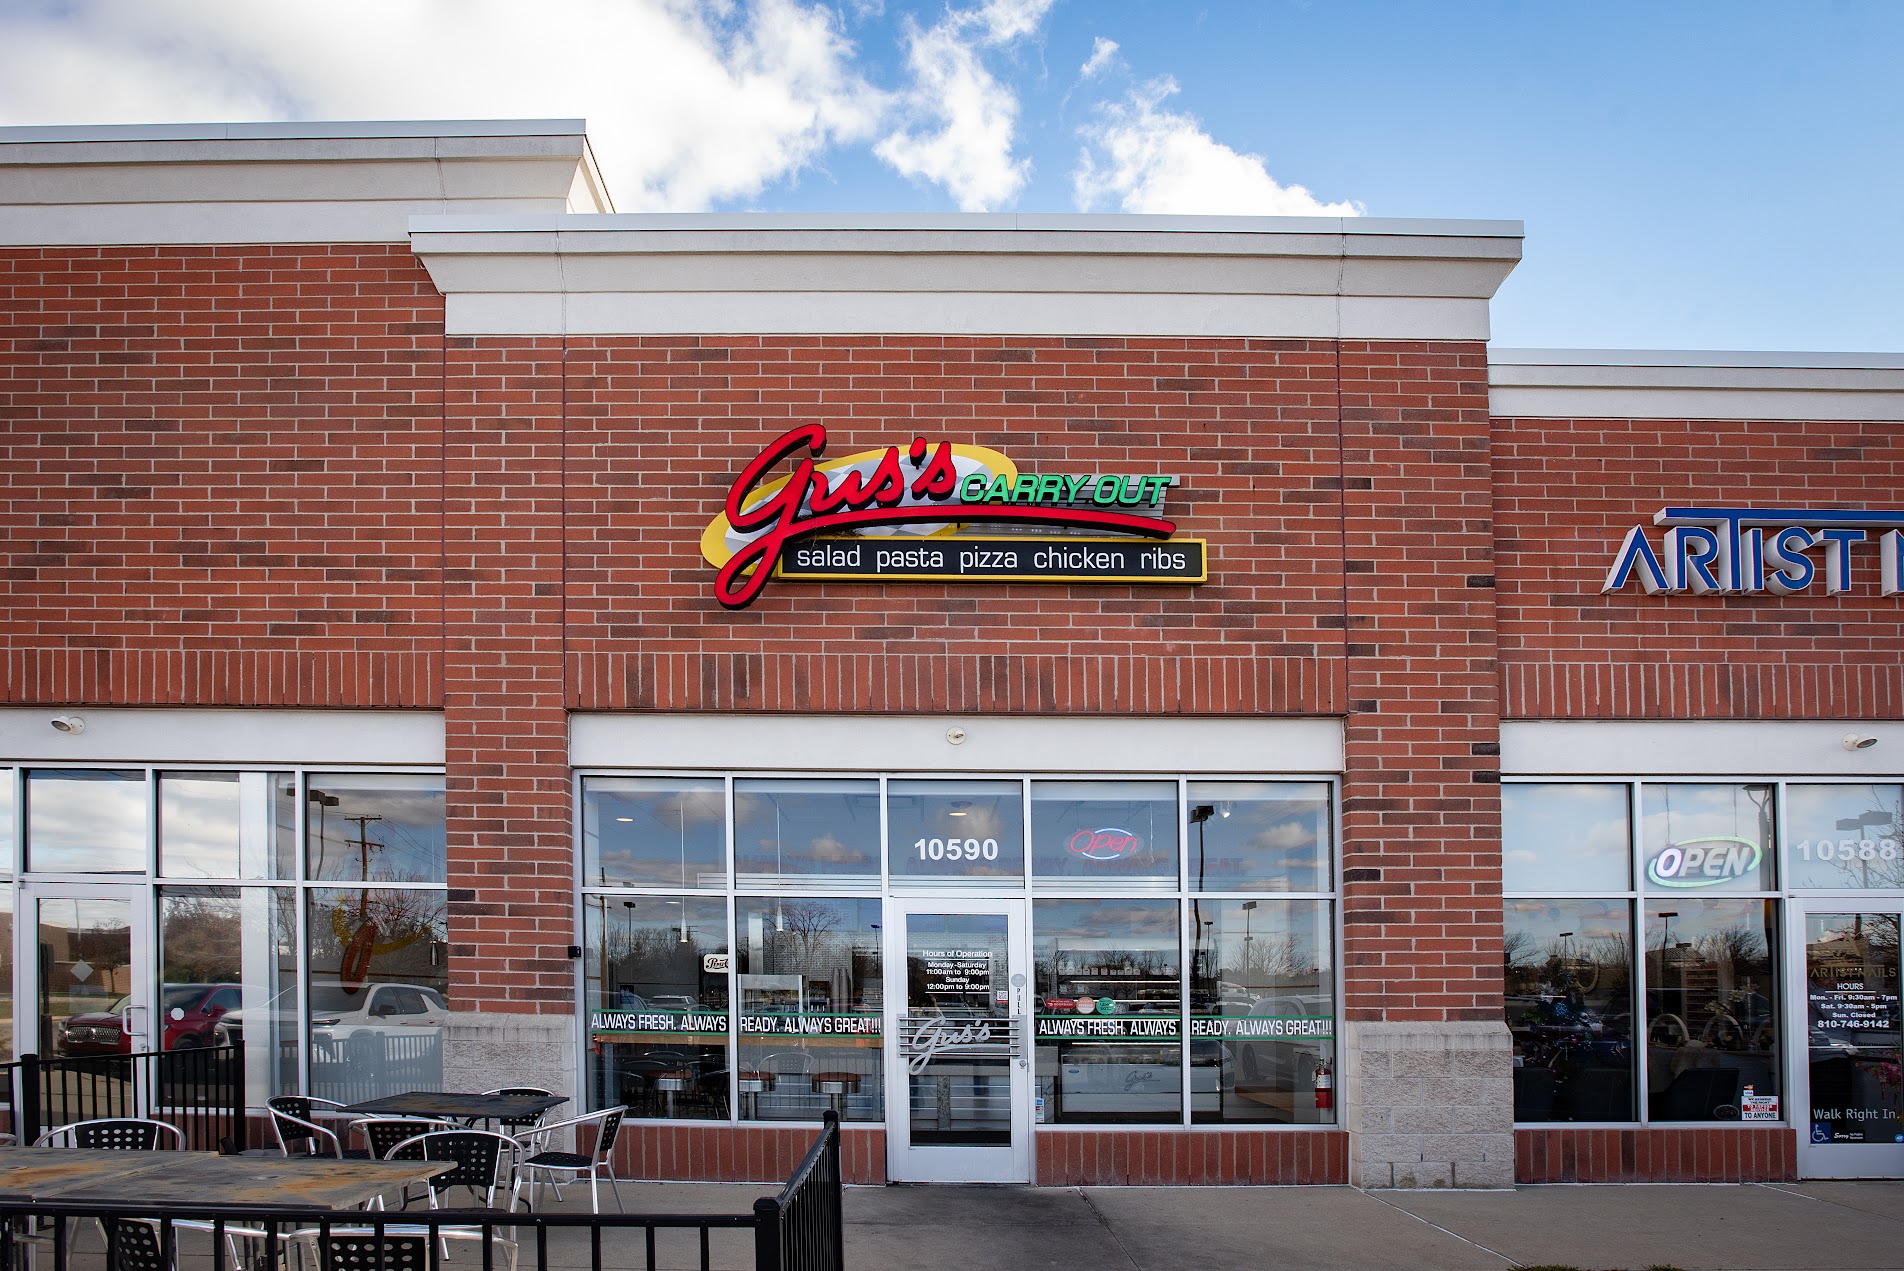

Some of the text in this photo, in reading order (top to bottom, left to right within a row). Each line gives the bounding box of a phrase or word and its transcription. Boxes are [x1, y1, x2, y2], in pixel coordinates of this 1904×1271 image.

[960, 474, 1172, 508] CARRY OUT
[715, 424, 957, 610] Gus's
[797, 545, 1186, 574] salad pasta pizza chicken ribs
[1602, 508, 1867, 595] ARTIST
[915, 838, 998, 860] 10590
[1070, 830, 1137, 854] Open
[1797, 839, 1897, 861] 10588
[1656, 847, 1751, 877] OPEN
[956, 950, 993, 958] Operation
[945, 976, 970, 984] Sunday
[964, 968, 990, 976] 9:00pm
[1837, 982, 1864, 990] HOURS
[1871, 1003, 1888, 1011] 5pm
[1881, 994, 1898, 1002] 7pm
[592, 1013, 881, 1034] ALWAYS FRESH. ALWAYS READY. ALWAYS GREAT!!!
[1039, 1019, 1332, 1036] ALWAYS FRESH. ALWAYS READY. ALWAYS GREAT!!!
[1817, 1019, 1890, 1028] 810-746-9142
[909, 1015, 991, 1075] Gus's
[1813, 1108, 1900, 1121] Walk Right In.
